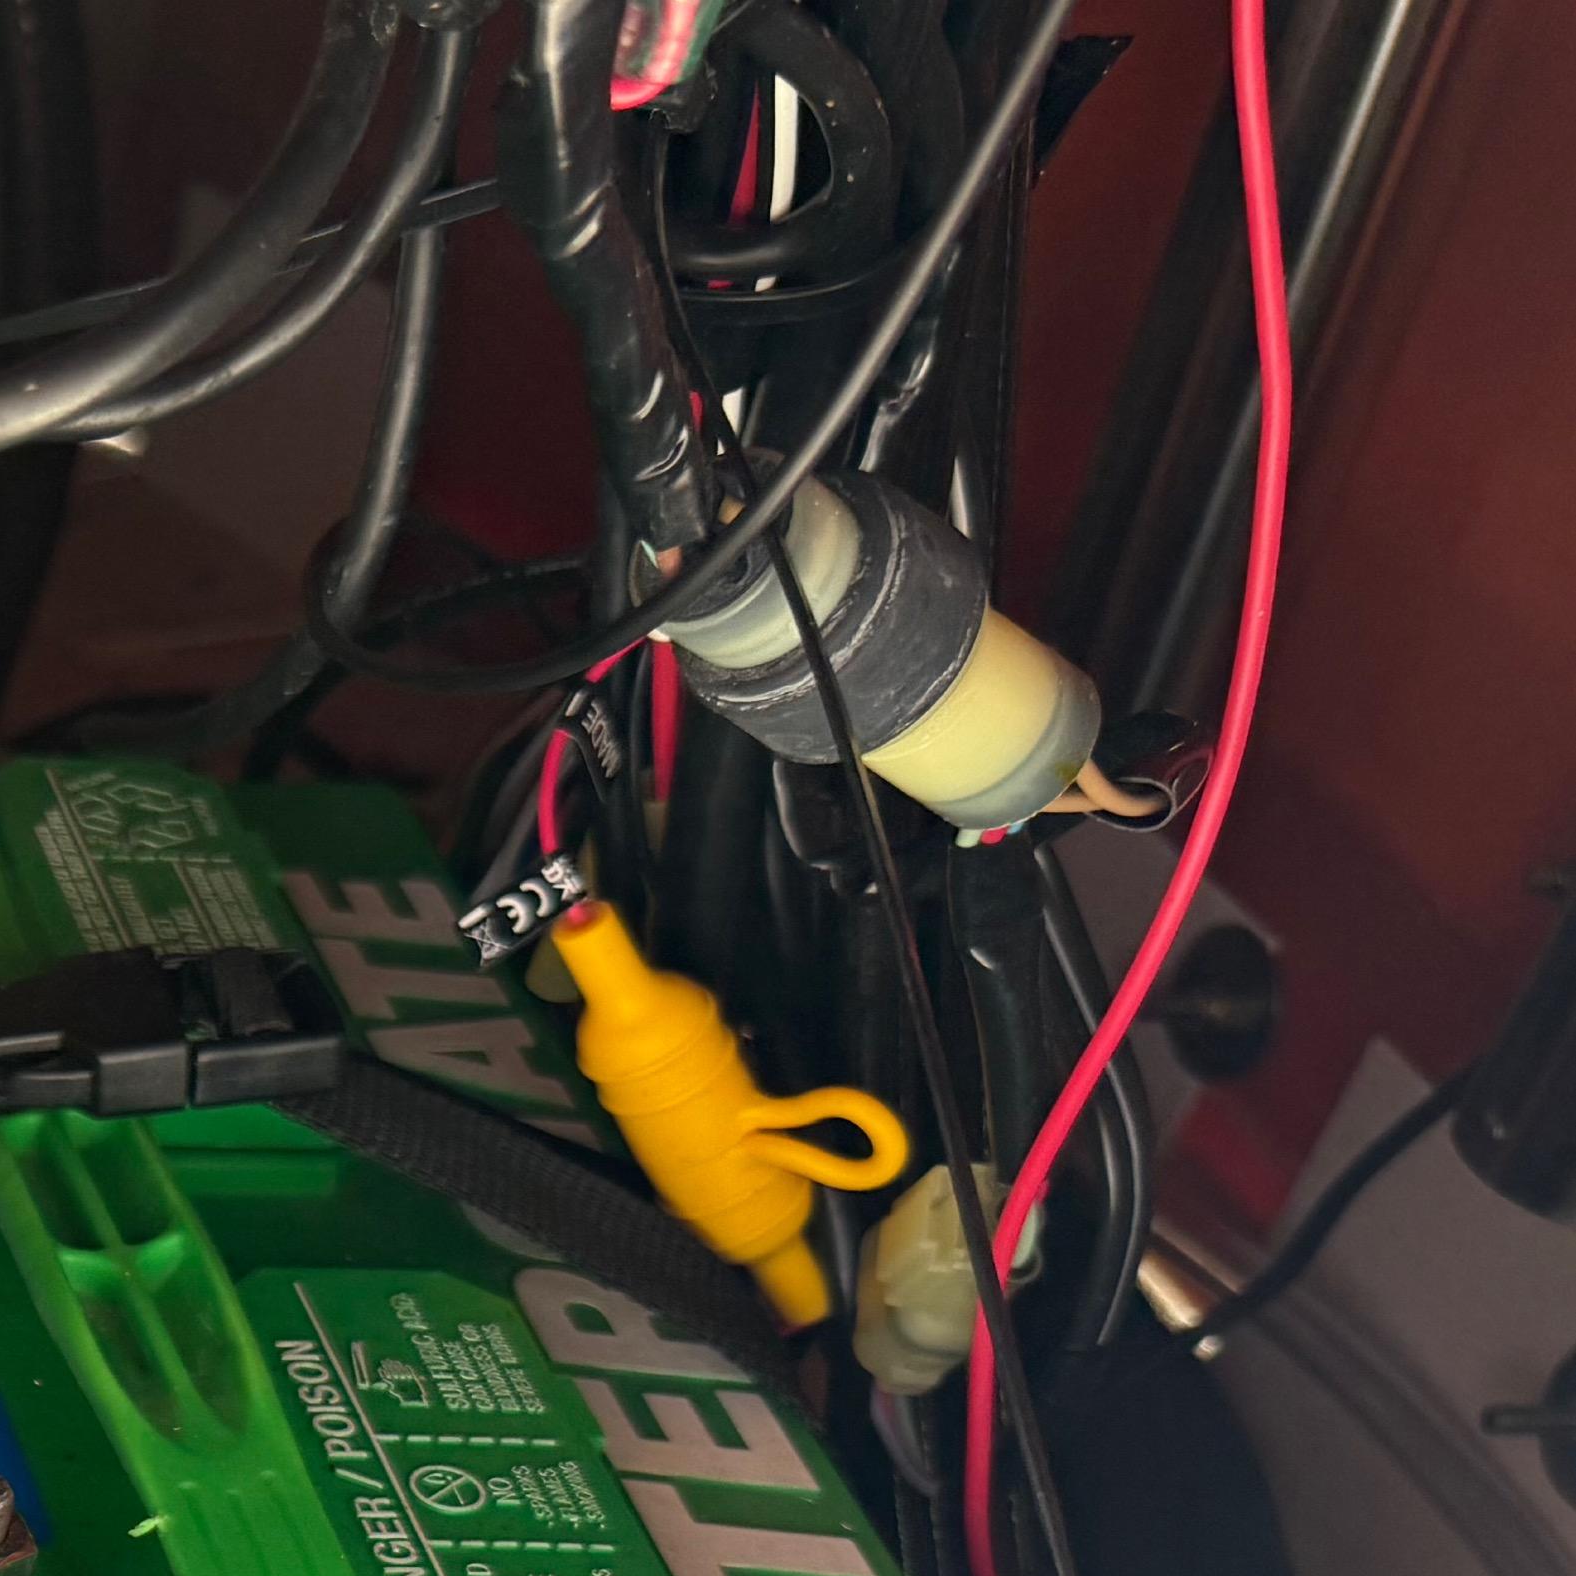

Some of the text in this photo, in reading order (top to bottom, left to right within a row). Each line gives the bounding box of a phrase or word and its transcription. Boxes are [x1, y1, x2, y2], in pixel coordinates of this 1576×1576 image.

[412, 1334, 469, 1409] SULFURIC
[443, 1342, 495, 1411] CAN CAUSE
[458, 1324, 520, 1411] BLINDNESS OR
[505, 1368, 545, 1413] SEVERE
[277, 1340, 366, 1458] POISON
[487, 1476, 521, 1505] NO
[511, 1464, 553, 1518] SPARKS
[538, 1467, 580, 1520] FLAMES
[559, 1461, 604, 1520] SMOKING
